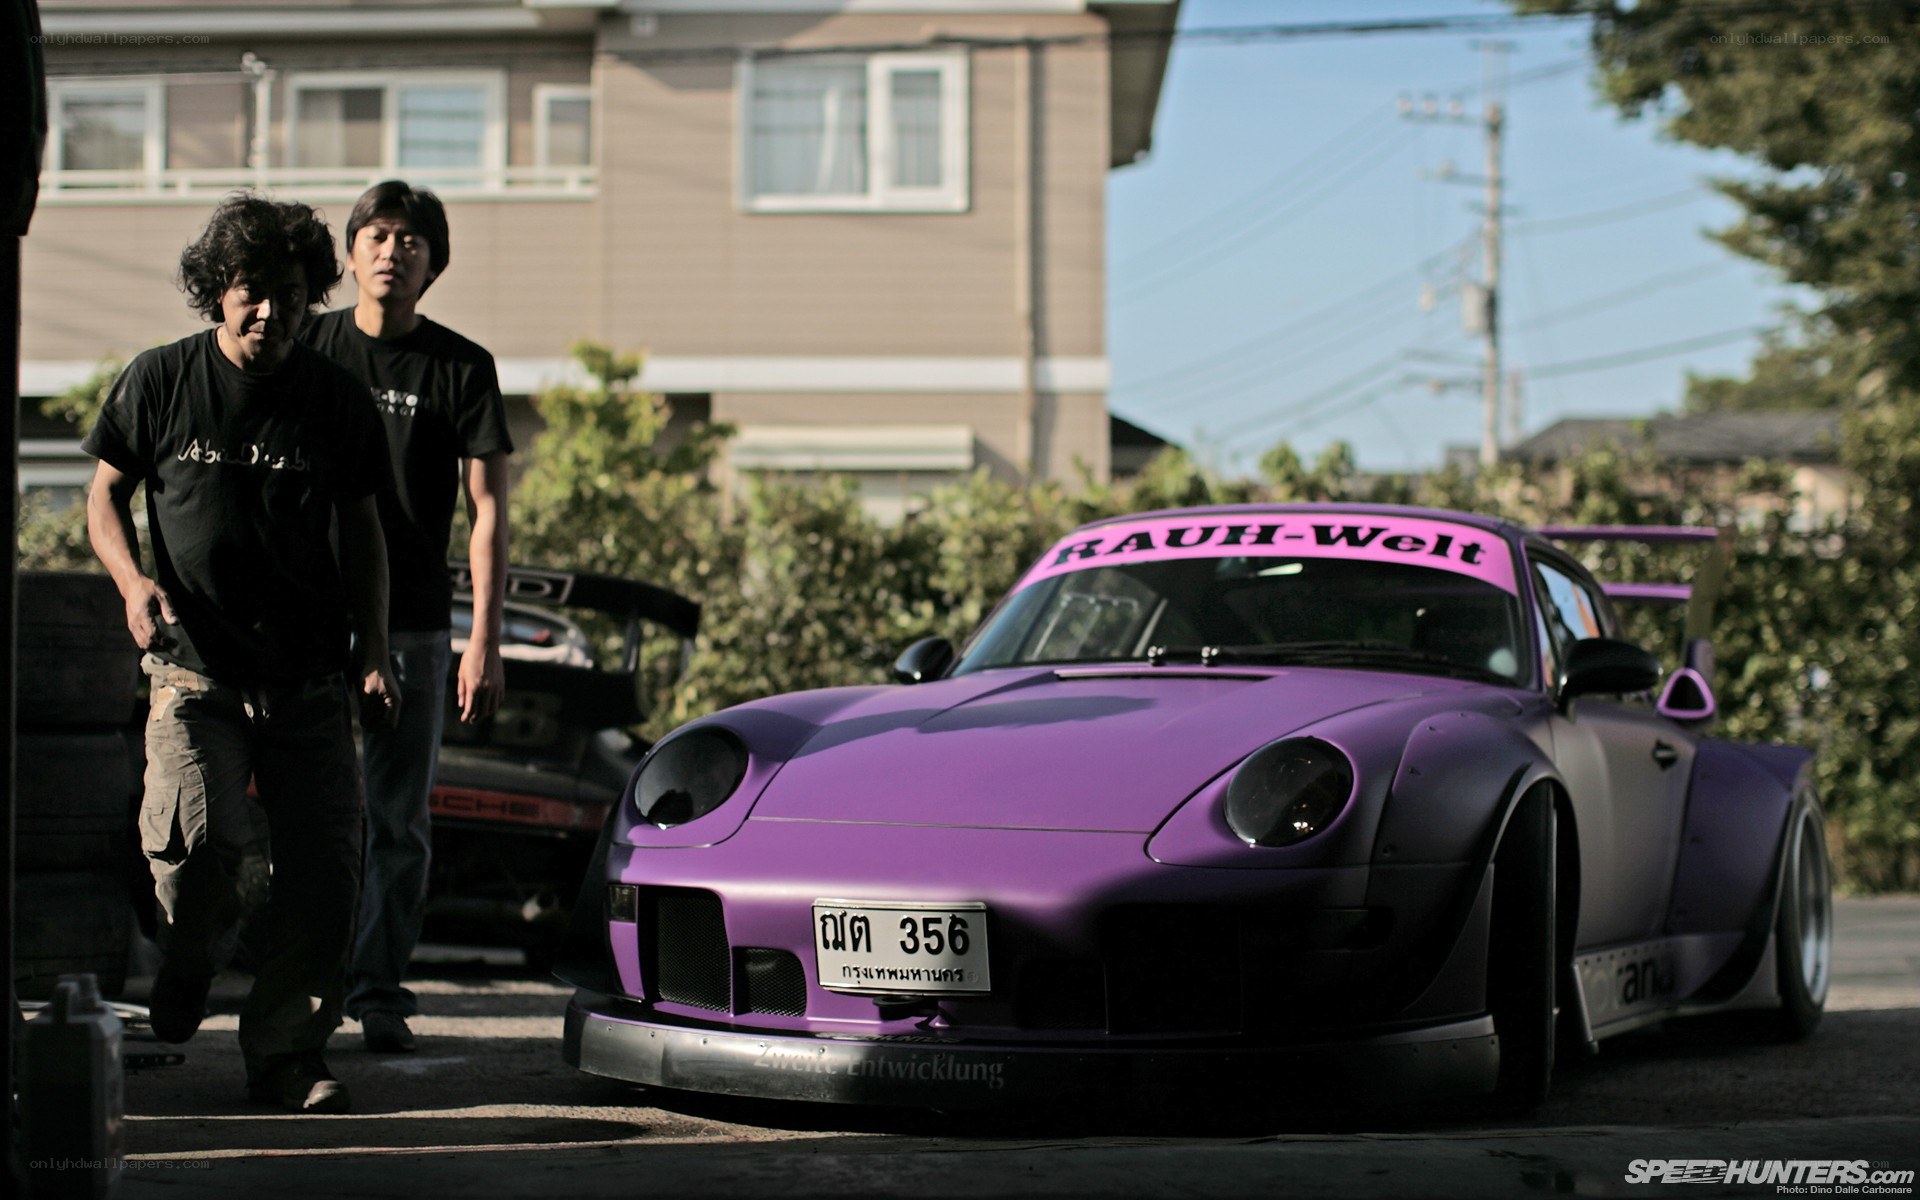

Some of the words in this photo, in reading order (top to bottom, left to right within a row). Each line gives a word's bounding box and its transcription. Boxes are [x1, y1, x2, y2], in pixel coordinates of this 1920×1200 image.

[1047, 524, 1487, 566] RAUH-Welt
[899, 915, 970, 955] 356
[842, 964, 964, 984] กรุงเทพมหานคร
[847, 1052, 1004, 1089] Entwicklung
